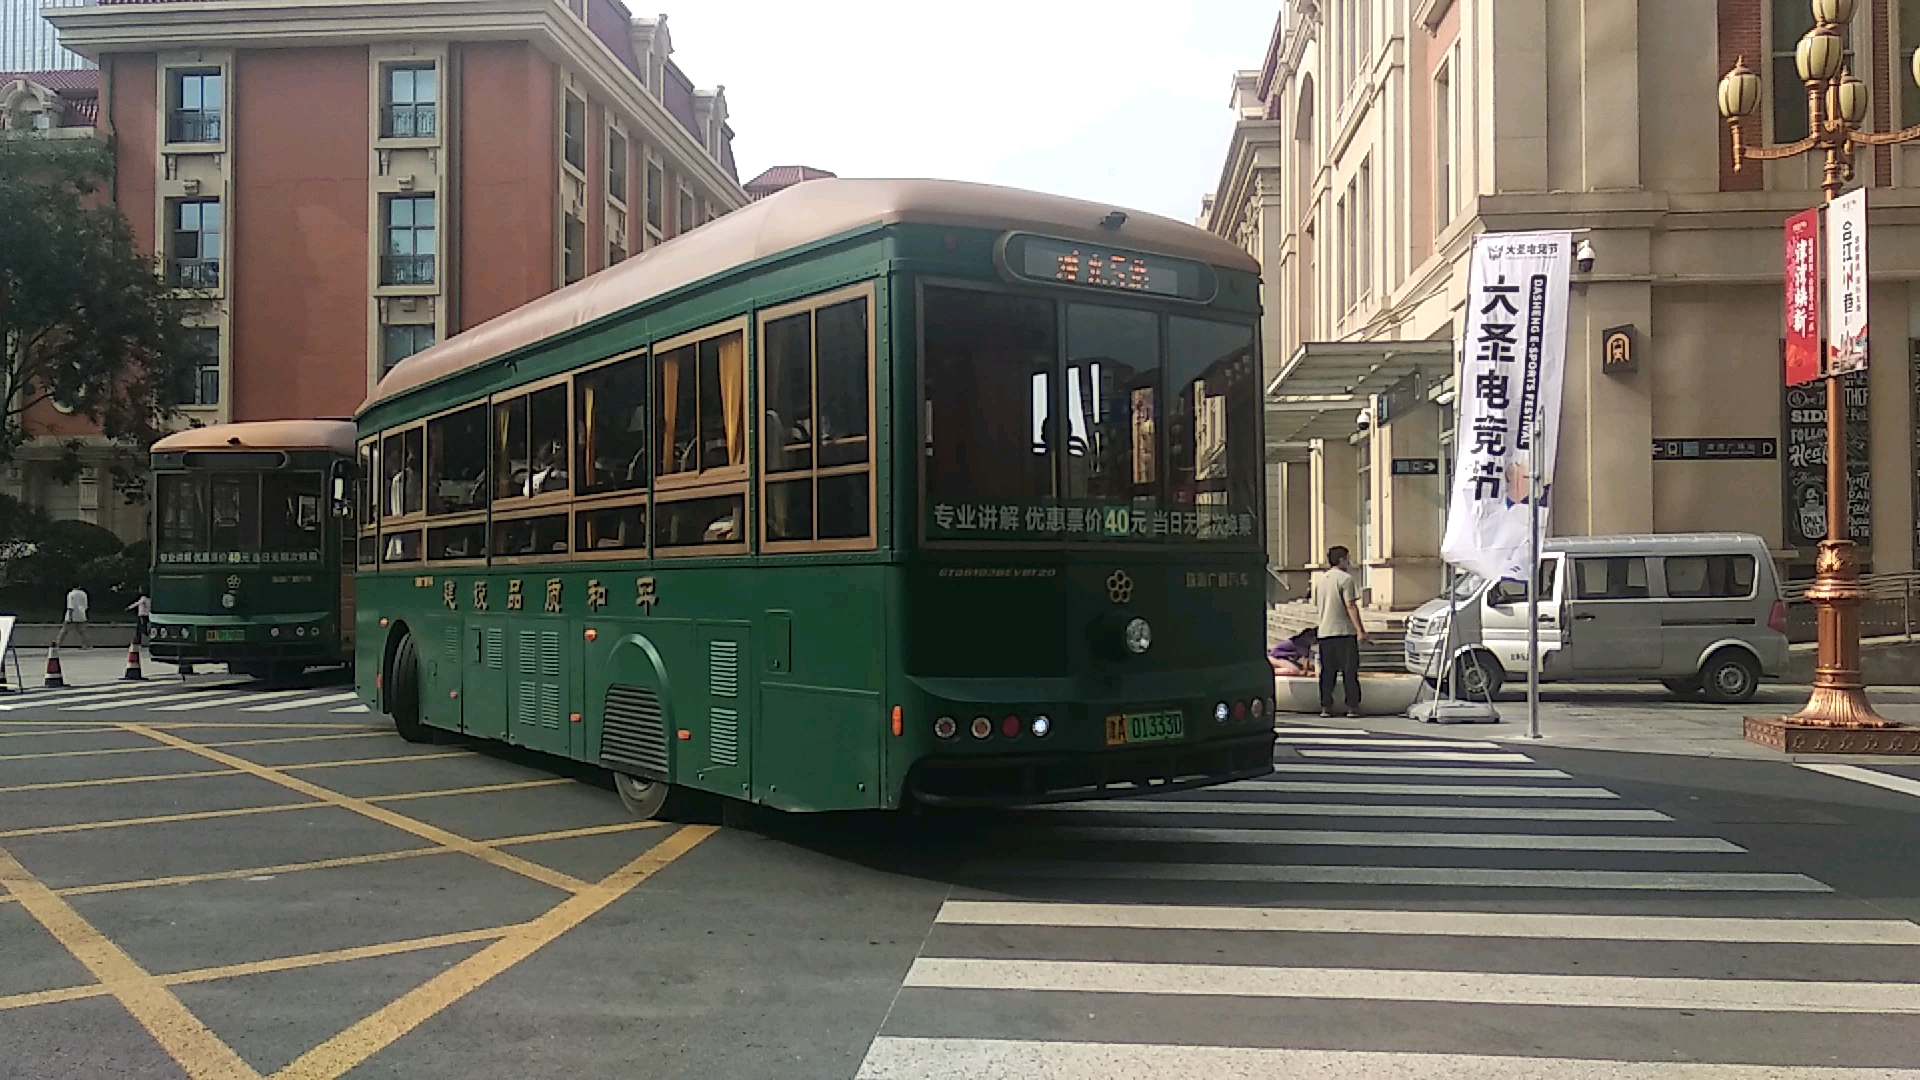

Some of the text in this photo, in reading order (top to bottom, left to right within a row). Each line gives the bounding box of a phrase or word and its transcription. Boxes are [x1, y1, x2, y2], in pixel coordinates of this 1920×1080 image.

[1530, 279, 1545, 334] DASHENG
[1518, 393, 1535, 447] FESTIVAL
[1762, 441, 1774, 455] D
[934, 503, 1021, 532] 专业讲解
[1025, 507, 1148, 537] 优惠票价40元
